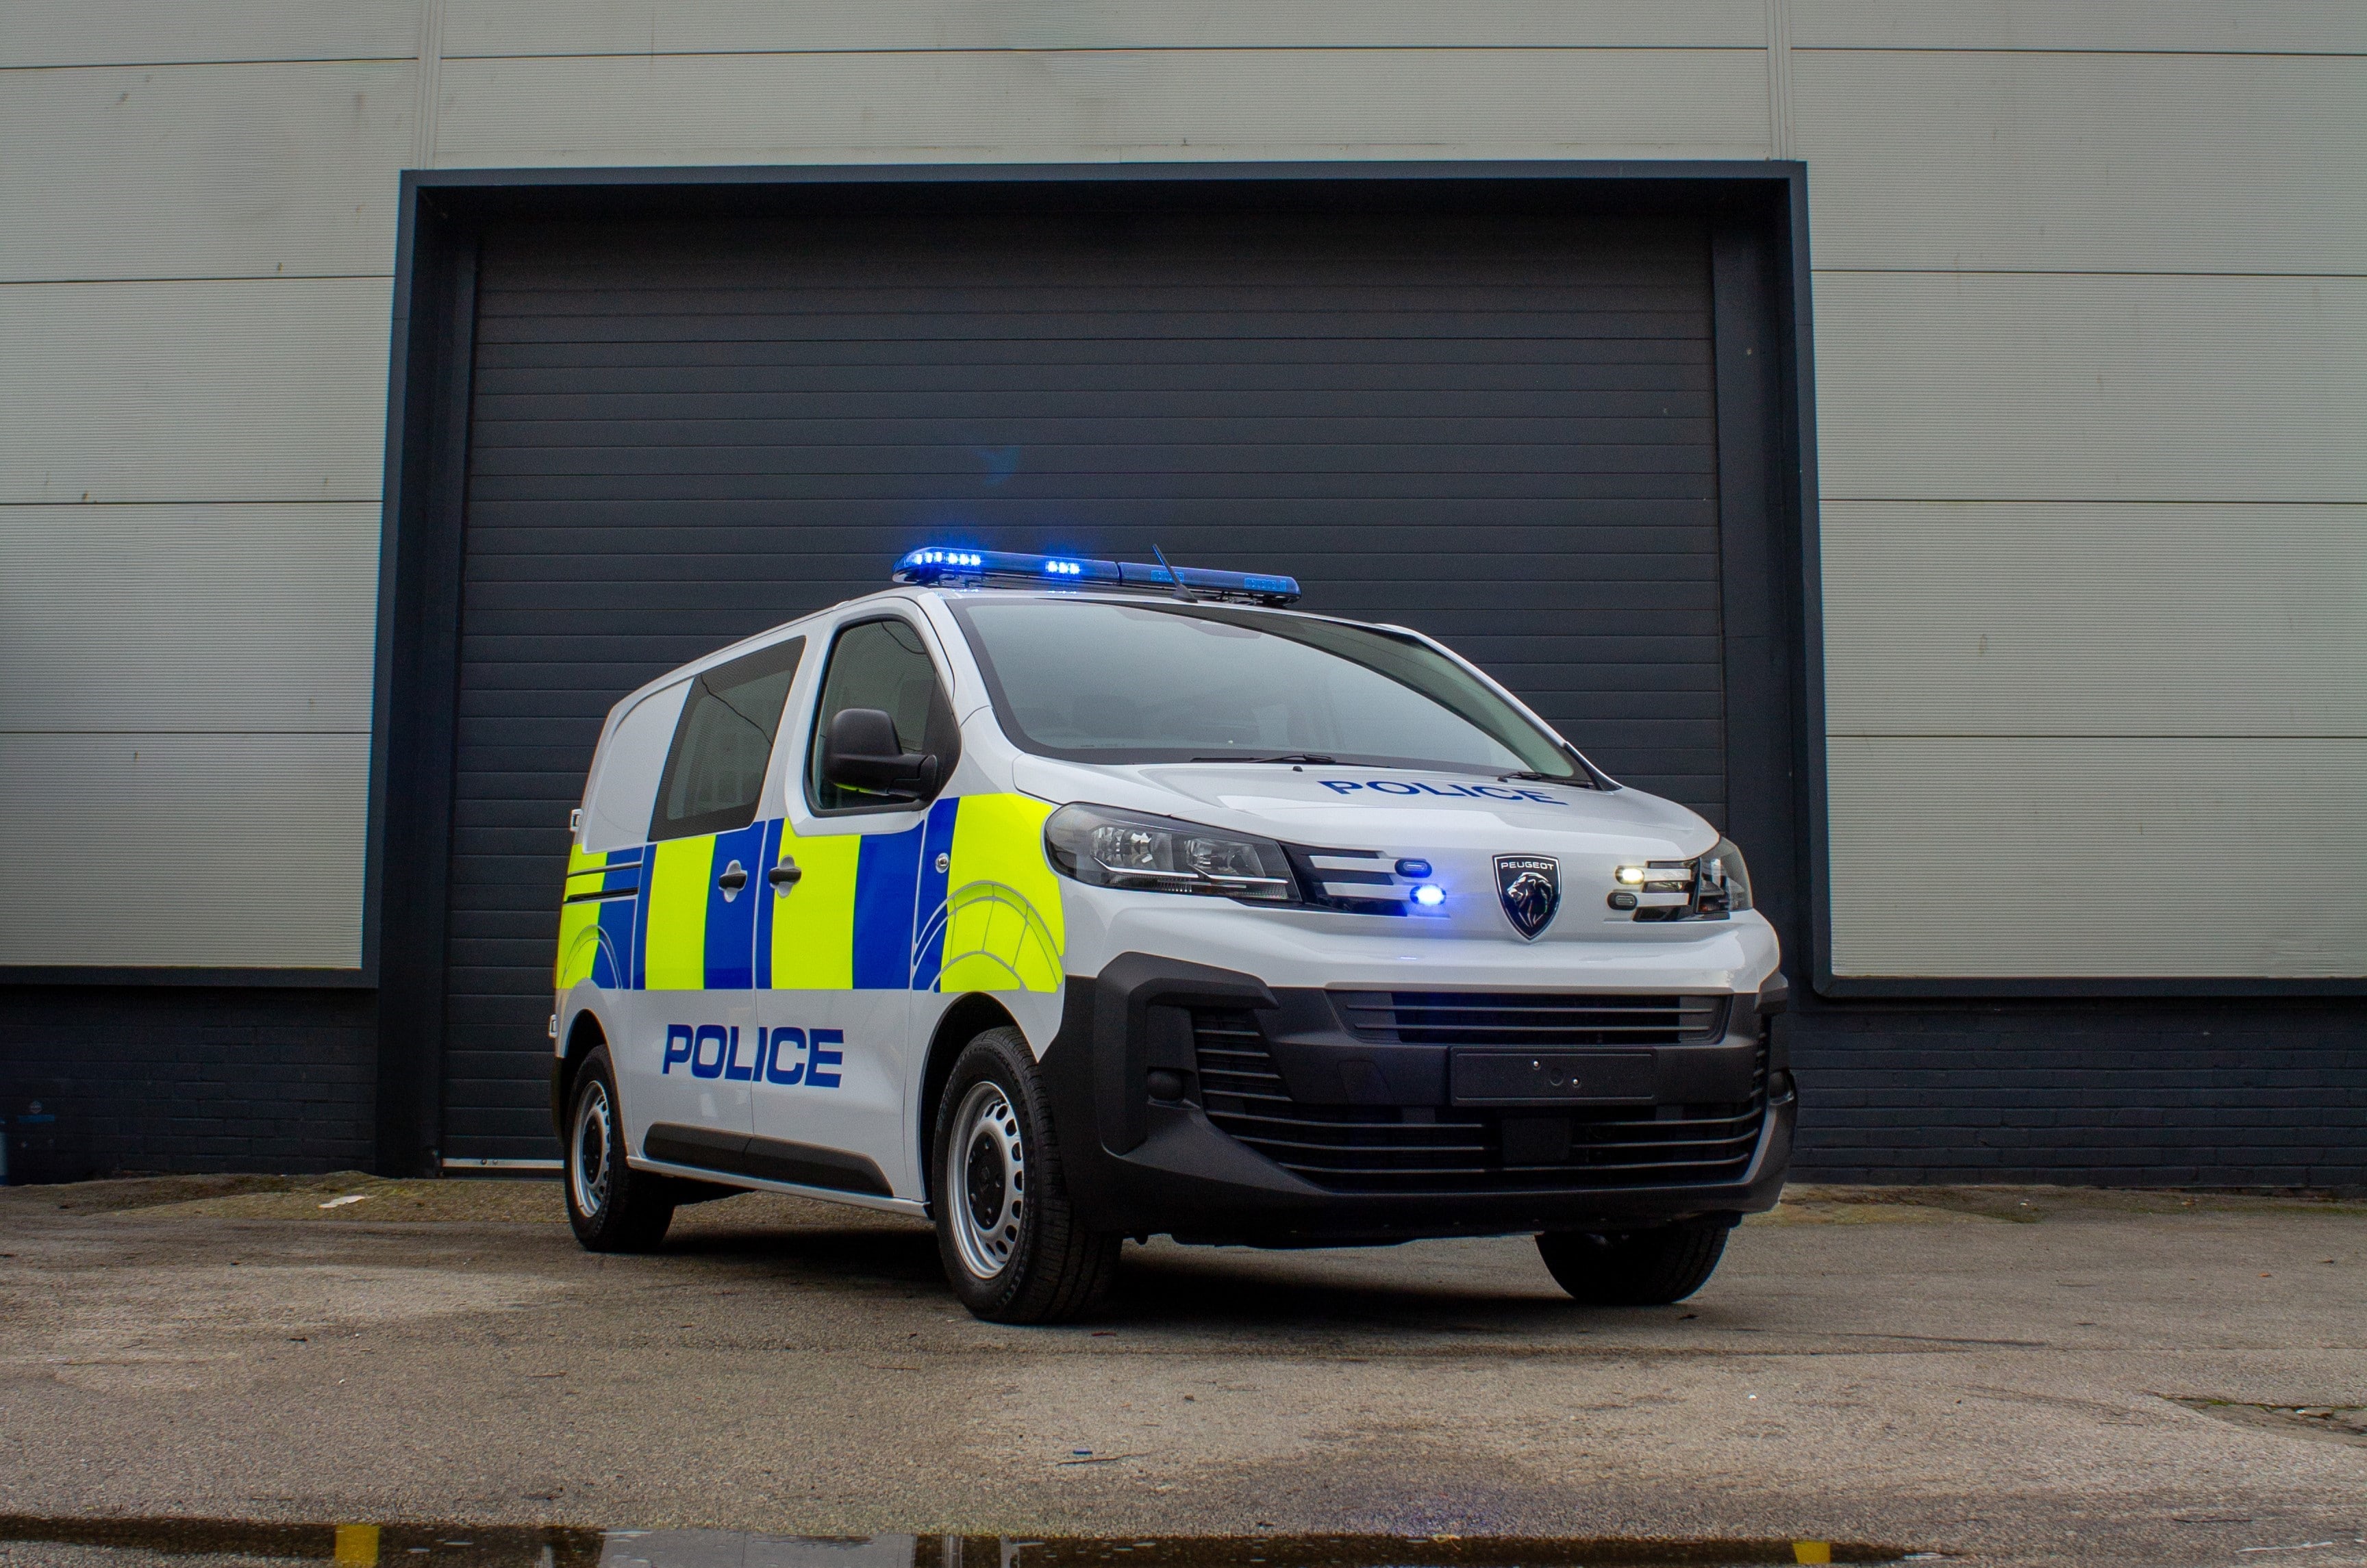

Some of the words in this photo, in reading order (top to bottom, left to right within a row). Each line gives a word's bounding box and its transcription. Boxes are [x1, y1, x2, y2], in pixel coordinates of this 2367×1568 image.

[1317, 781, 1569, 805] POLICE
[1501, 861, 1554, 870] PEUGEOT
[662, 1024, 844, 1088] POLICE
